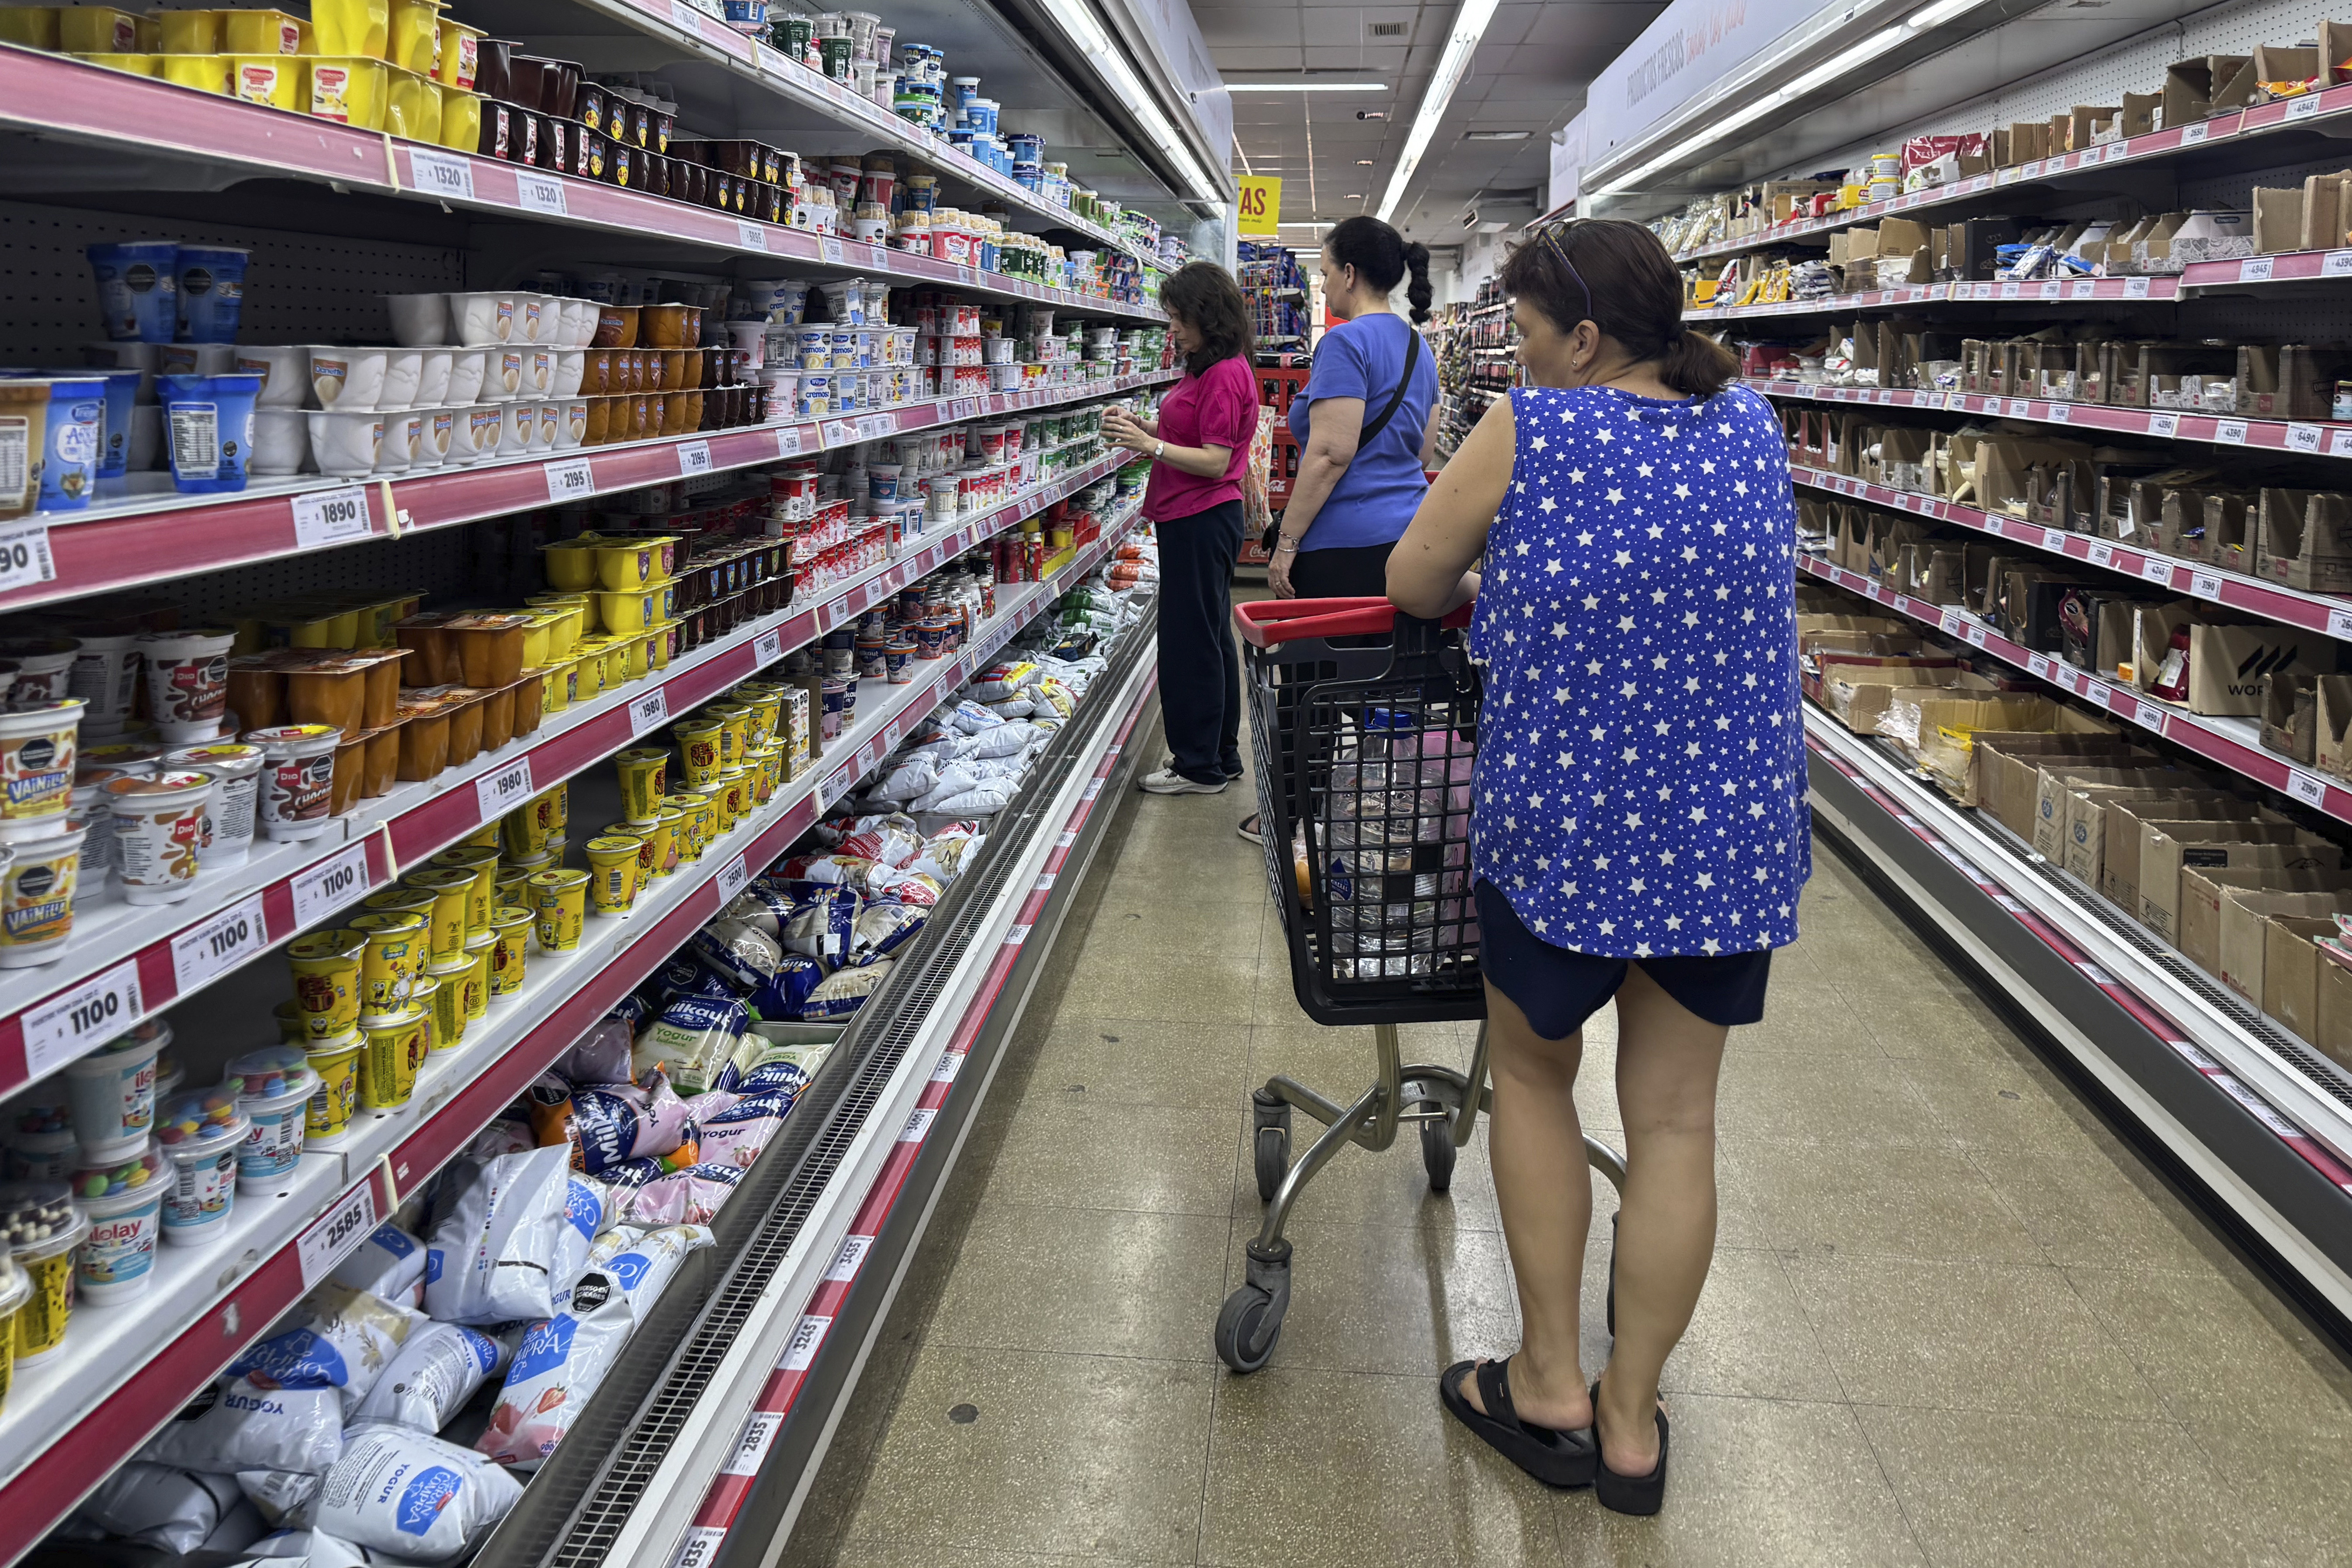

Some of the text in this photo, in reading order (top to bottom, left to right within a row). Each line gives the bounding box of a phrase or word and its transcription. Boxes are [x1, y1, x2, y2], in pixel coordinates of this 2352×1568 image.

[1627, 52, 1657, 109] PRODUCTOS
[1658, 28, 1684, 86] FRESCOS
[319, 85, 340, 94] Postre
[434, 166, 461, 186] 1320
[535, 185, 556, 203] 1320
[316, 365, 345, 377] Danette
[2297, 431, 2315, 444] 6490
[691, 452, 705, 465] 2195
[564, 471, 584, 488] 2195
[322, 501, 356, 524] 1890
[763, 638, 775, 653] 1980
[643, 698, 660, 718] 1980
[498, 770, 521, 795] 1980
[323, 865, 353, 898] 1100
[728, 867, 742, 888] 2500
[210, 919, 247, 957] 1100
[70, 992, 118, 1035] 1100
[656, 1037, 687, 1048] balance
[657, 1027, 697, 1042] Yogur
[760, 1053, 797, 1063] Yogur
[702, 1127, 746, 1139] Yogur
[327, 1203, 362, 1249] 2585
[840, 1241, 862, 1264] 3455
[793, 1322, 818, 1351] 3245
[225, 1394, 284, 1415] YOGUR
[742, 1421, 768, 1453] 2835
[377, 1463, 411, 1504] YOGUR
